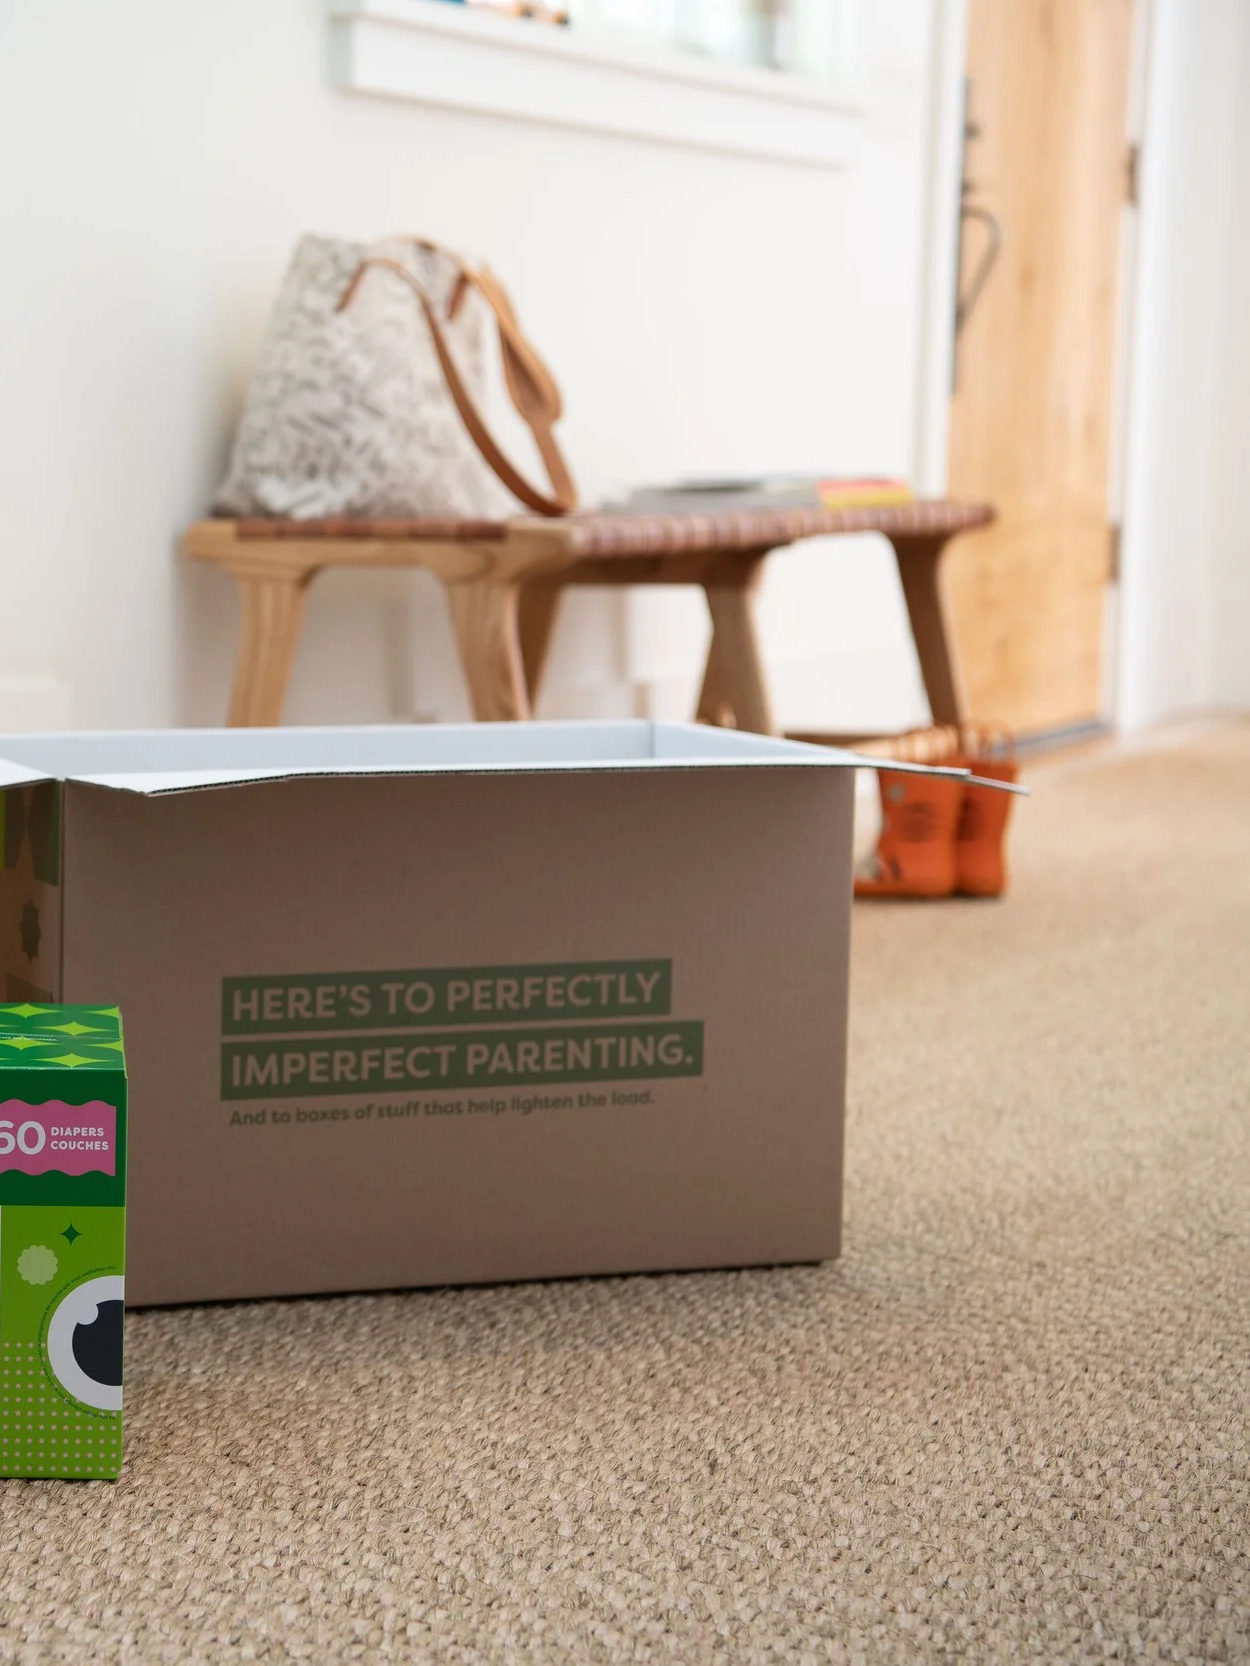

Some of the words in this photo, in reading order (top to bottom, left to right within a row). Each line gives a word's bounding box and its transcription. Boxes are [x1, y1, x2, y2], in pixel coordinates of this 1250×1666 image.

[233, 984, 371, 1021] HERE'S
[381, 981, 435, 1015] TO
[447, 971, 661, 1012] PERFECTLY
[232, 1045, 456, 1087] IMPERFECT
[467, 1033, 693, 1076] PARENTING.
[229, 1110, 266, 1127] And
[271, 1110, 291, 1123] to
[296, 1108, 349, 1123] boxes
[354, 1103, 375, 1120] of
[377, 1101, 421, 1119] stuff
[424, 1099, 463, 1116] that
[467, 1097, 506, 1115] help
[510, 1095, 573, 1115] lighten
[578, 1092, 607, 1108] the
[50, 1127, 104, 1137] DIAPERS
[50, 1140, 108, 1150] COUCHES
